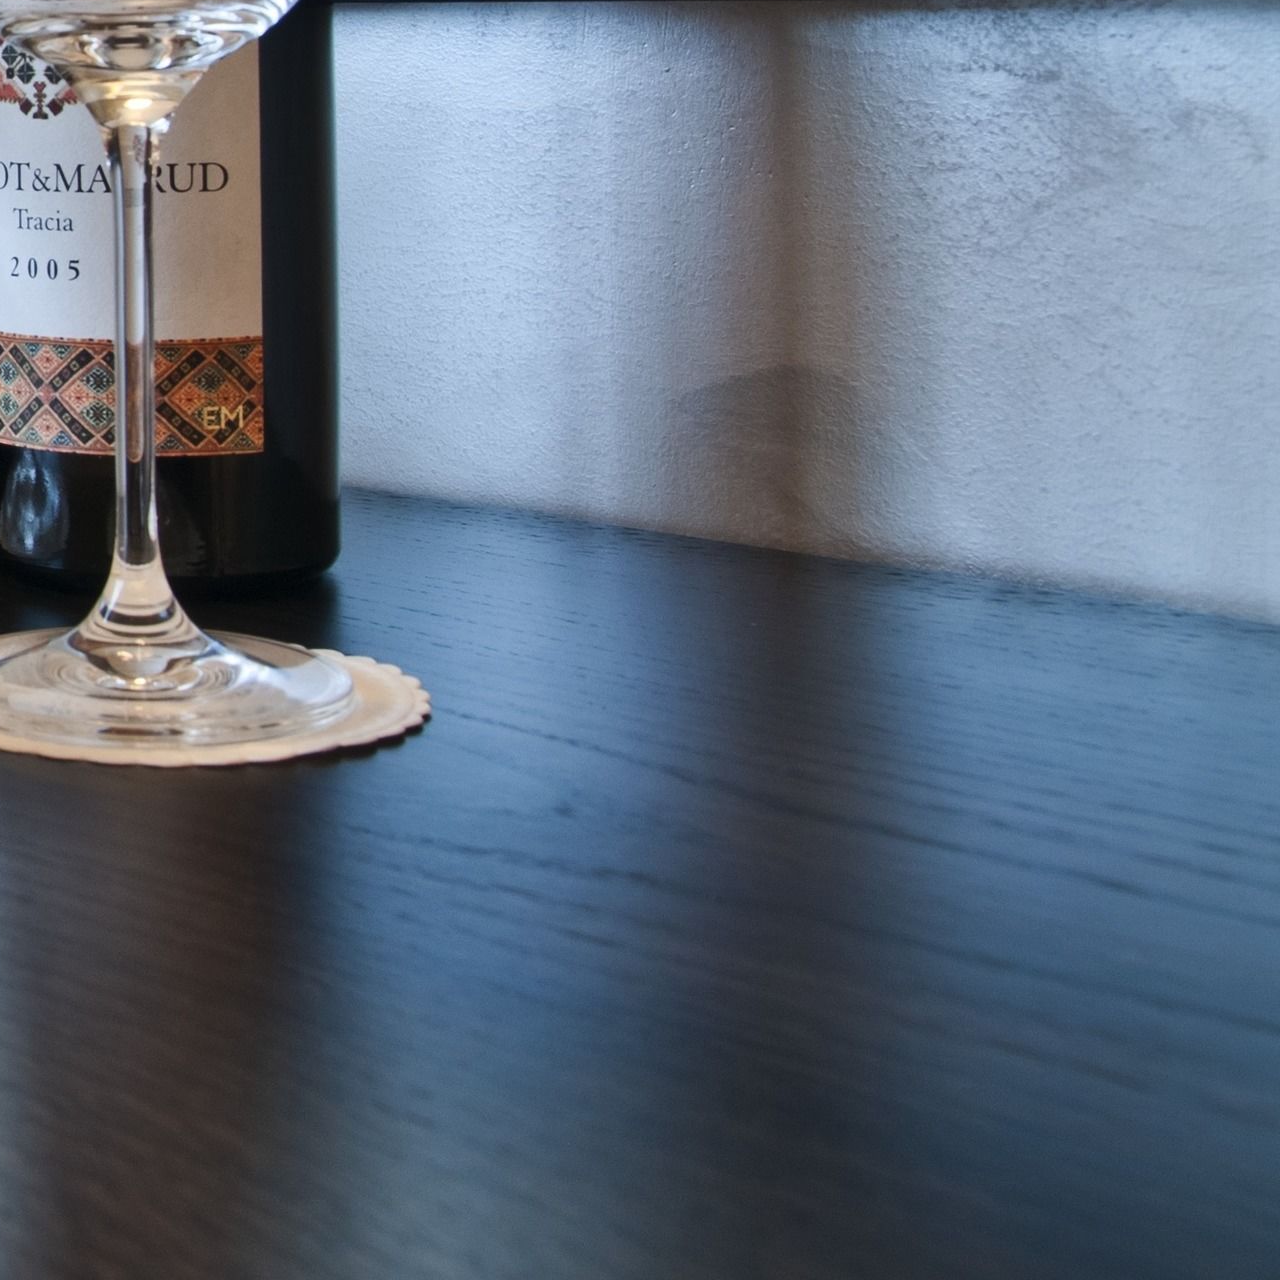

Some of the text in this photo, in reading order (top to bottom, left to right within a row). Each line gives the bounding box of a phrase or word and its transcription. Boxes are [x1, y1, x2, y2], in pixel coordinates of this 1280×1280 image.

[12, 207, 74, 232] Tracia
[10, 256, 80, 281] 2005
[203, 405, 244, 430] EM
